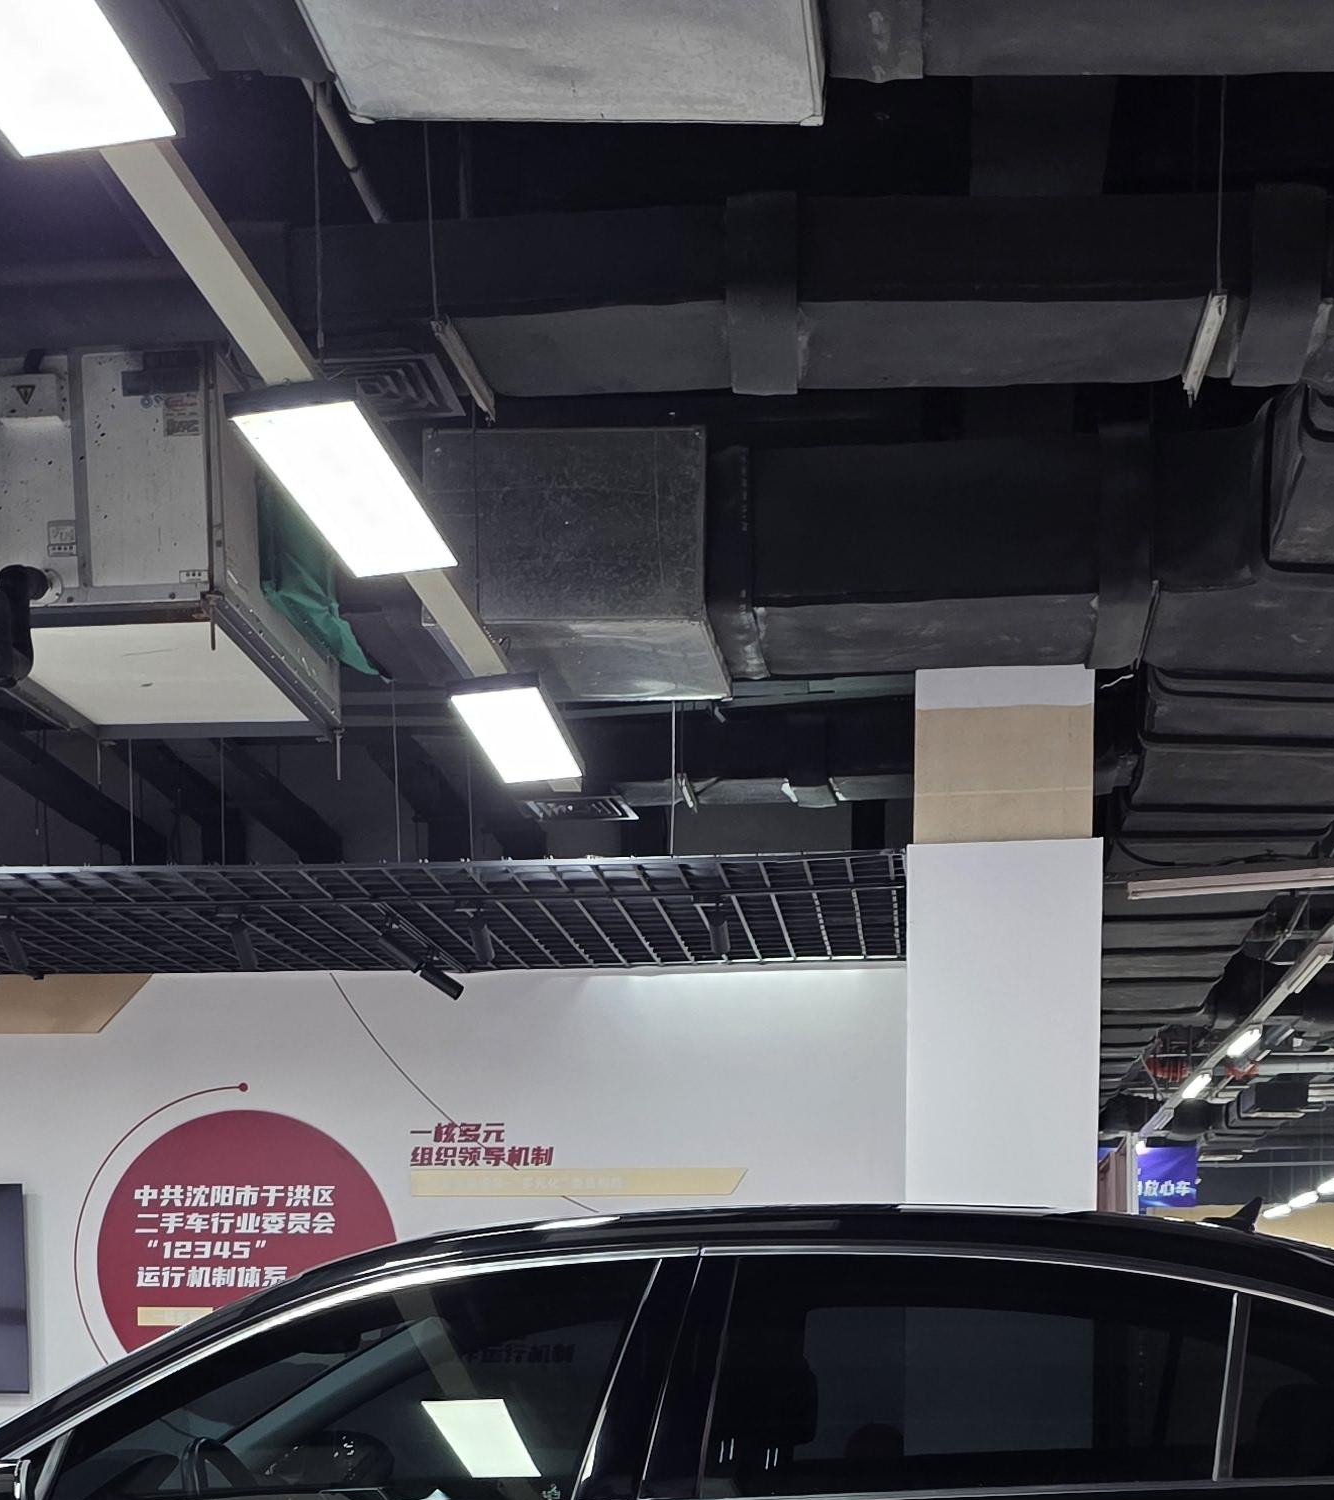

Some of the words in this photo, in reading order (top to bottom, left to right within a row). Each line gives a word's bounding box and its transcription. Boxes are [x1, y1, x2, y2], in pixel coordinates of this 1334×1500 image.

[410, 1122, 505, 1143] 一核多元
[410, 1146, 554, 1167] 组织领导机制
[134, 1184, 336, 1207] 中共沈阳市于洪区
[1138, 1179, 1191, 1197] 放心车
[134, 1212, 336, 1234] 二手车行业委员会
[147, 1240, 267, 1259] “12345”
[136, 1266, 288, 1288] 运行机制体系
